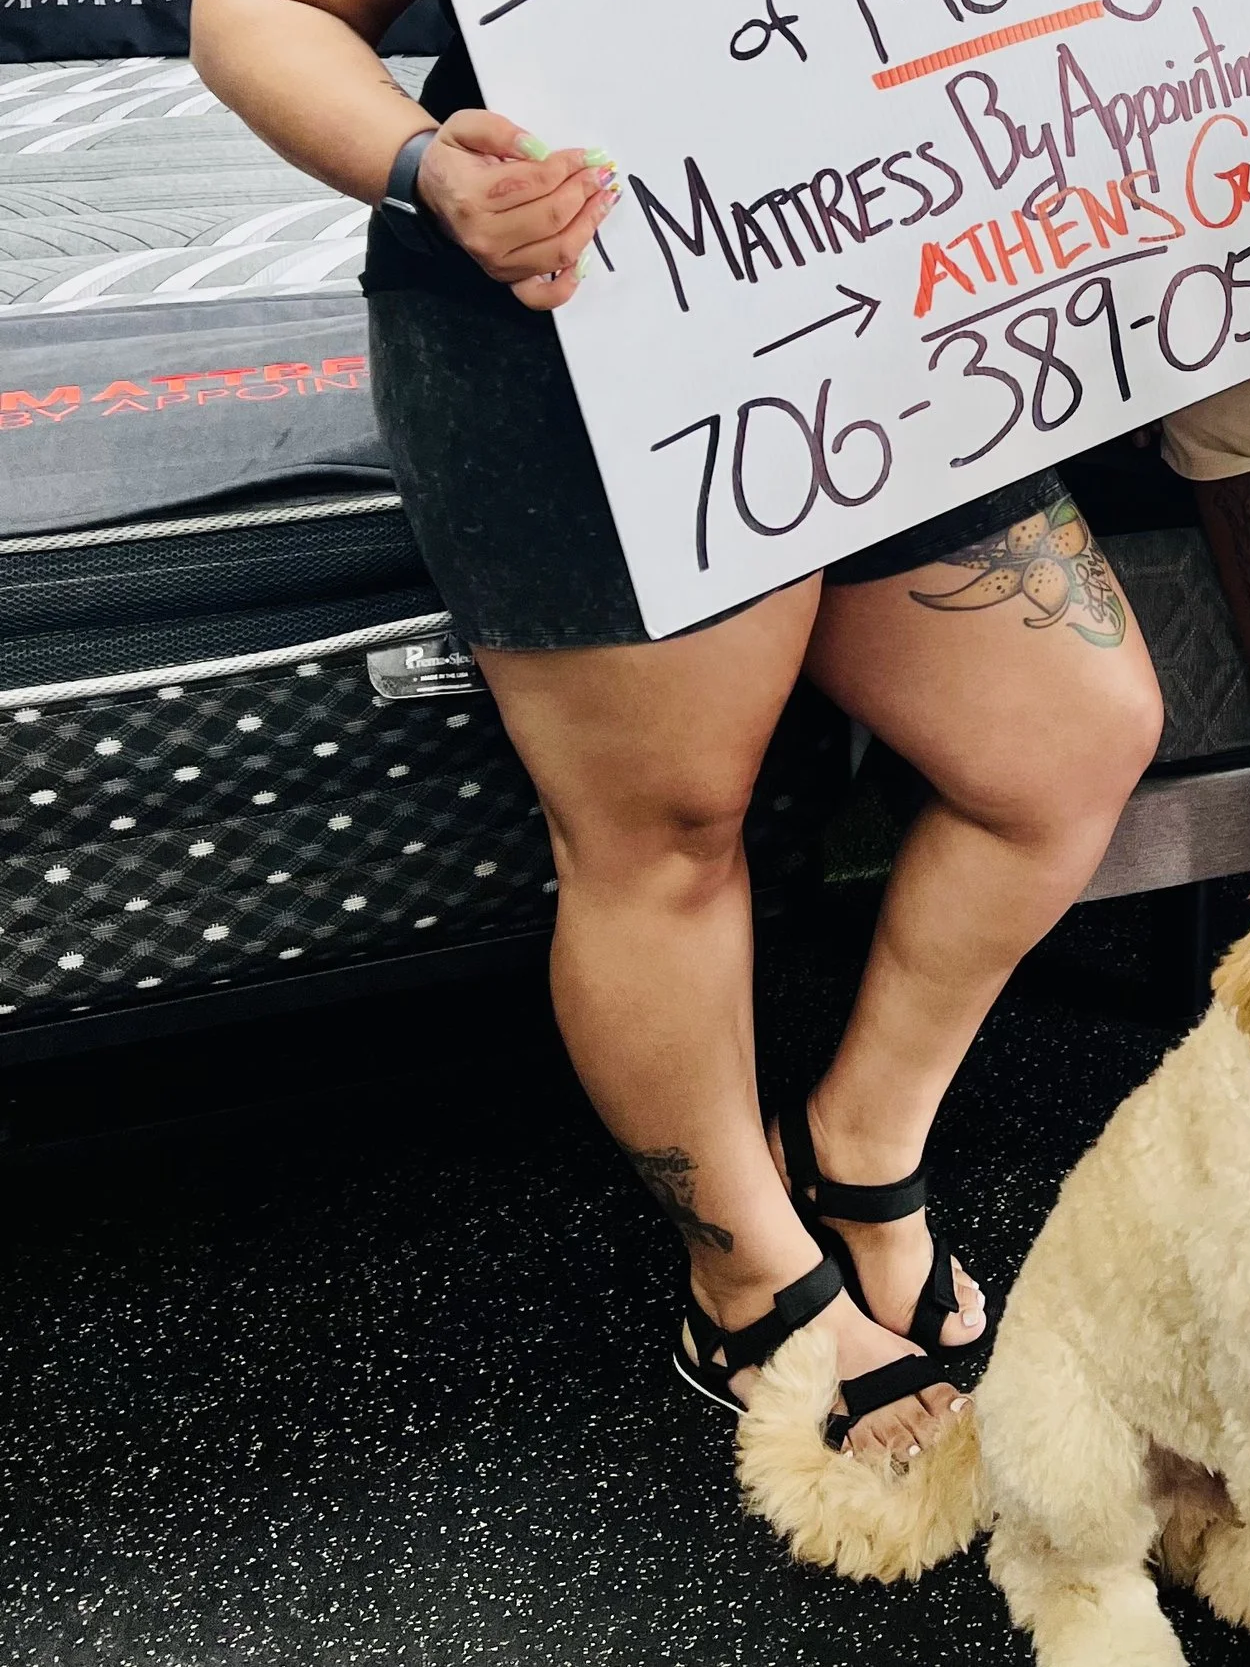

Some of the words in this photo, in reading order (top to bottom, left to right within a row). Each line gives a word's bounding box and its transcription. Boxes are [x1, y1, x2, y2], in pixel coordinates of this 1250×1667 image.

[627, 139, 964, 313] MATTRESS
[912, 168, 1187, 318] ATHENS
[102, 371, 369, 417] APPOIN
